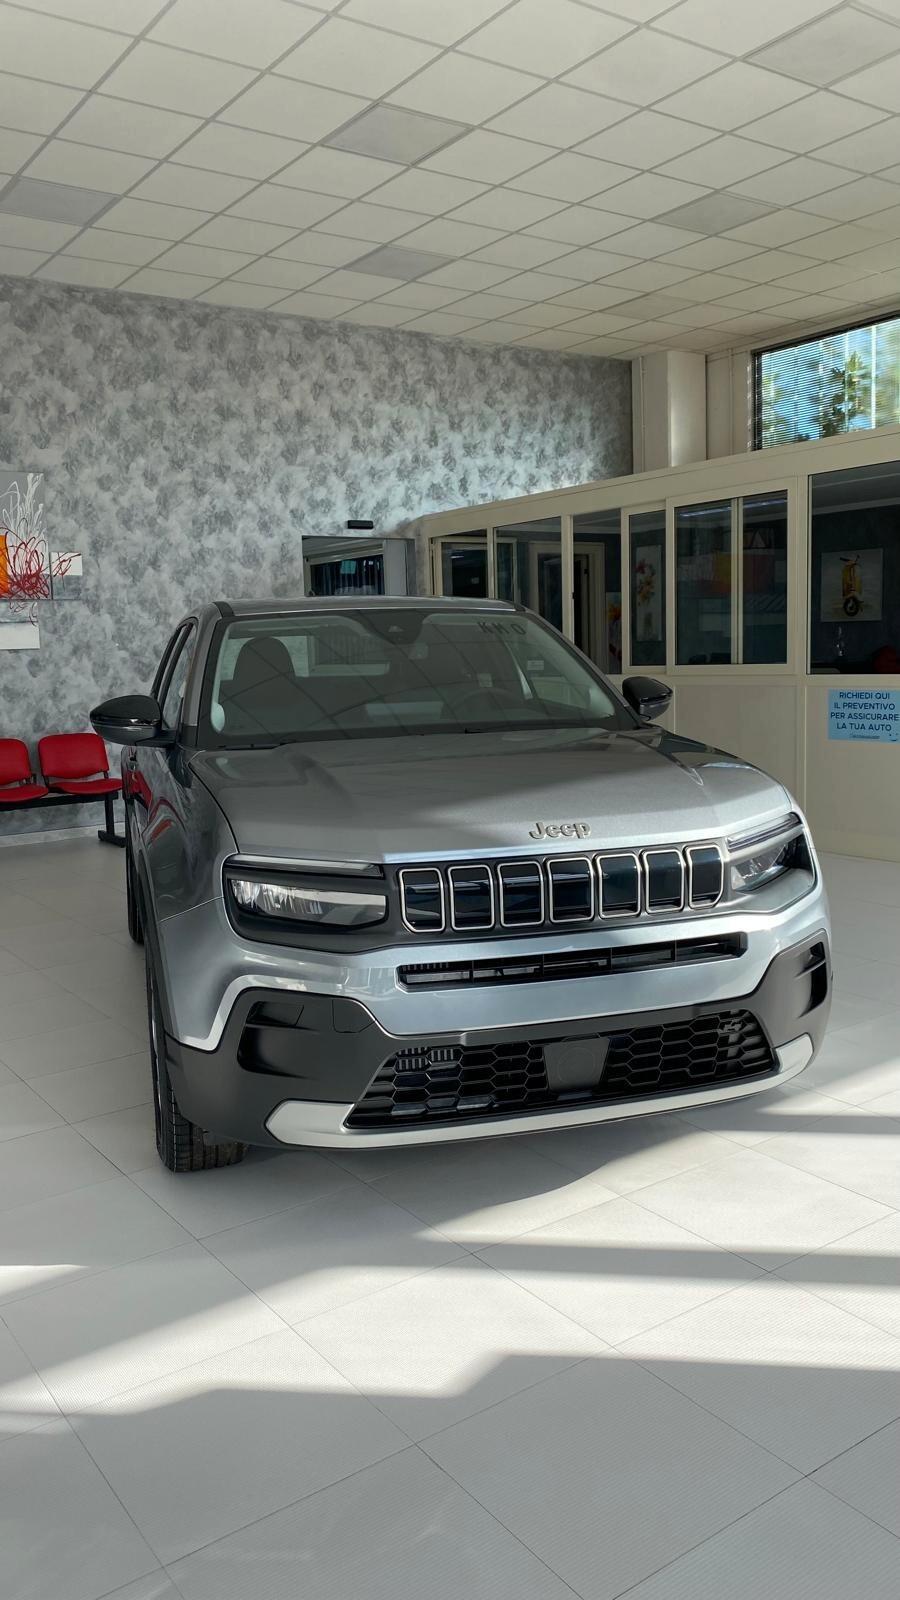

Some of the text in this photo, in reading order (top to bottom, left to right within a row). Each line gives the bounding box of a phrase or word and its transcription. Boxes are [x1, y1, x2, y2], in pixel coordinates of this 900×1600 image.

[874, 692, 890, 700] QUI
[842, 702, 896, 710] PREVENTIVO
[847, 712, 900, 721] ASSICURARE
[849, 722, 866, 731] TUA
[868, 723, 892, 732] AUTO
[528, 821, 591, 840] Jeep
